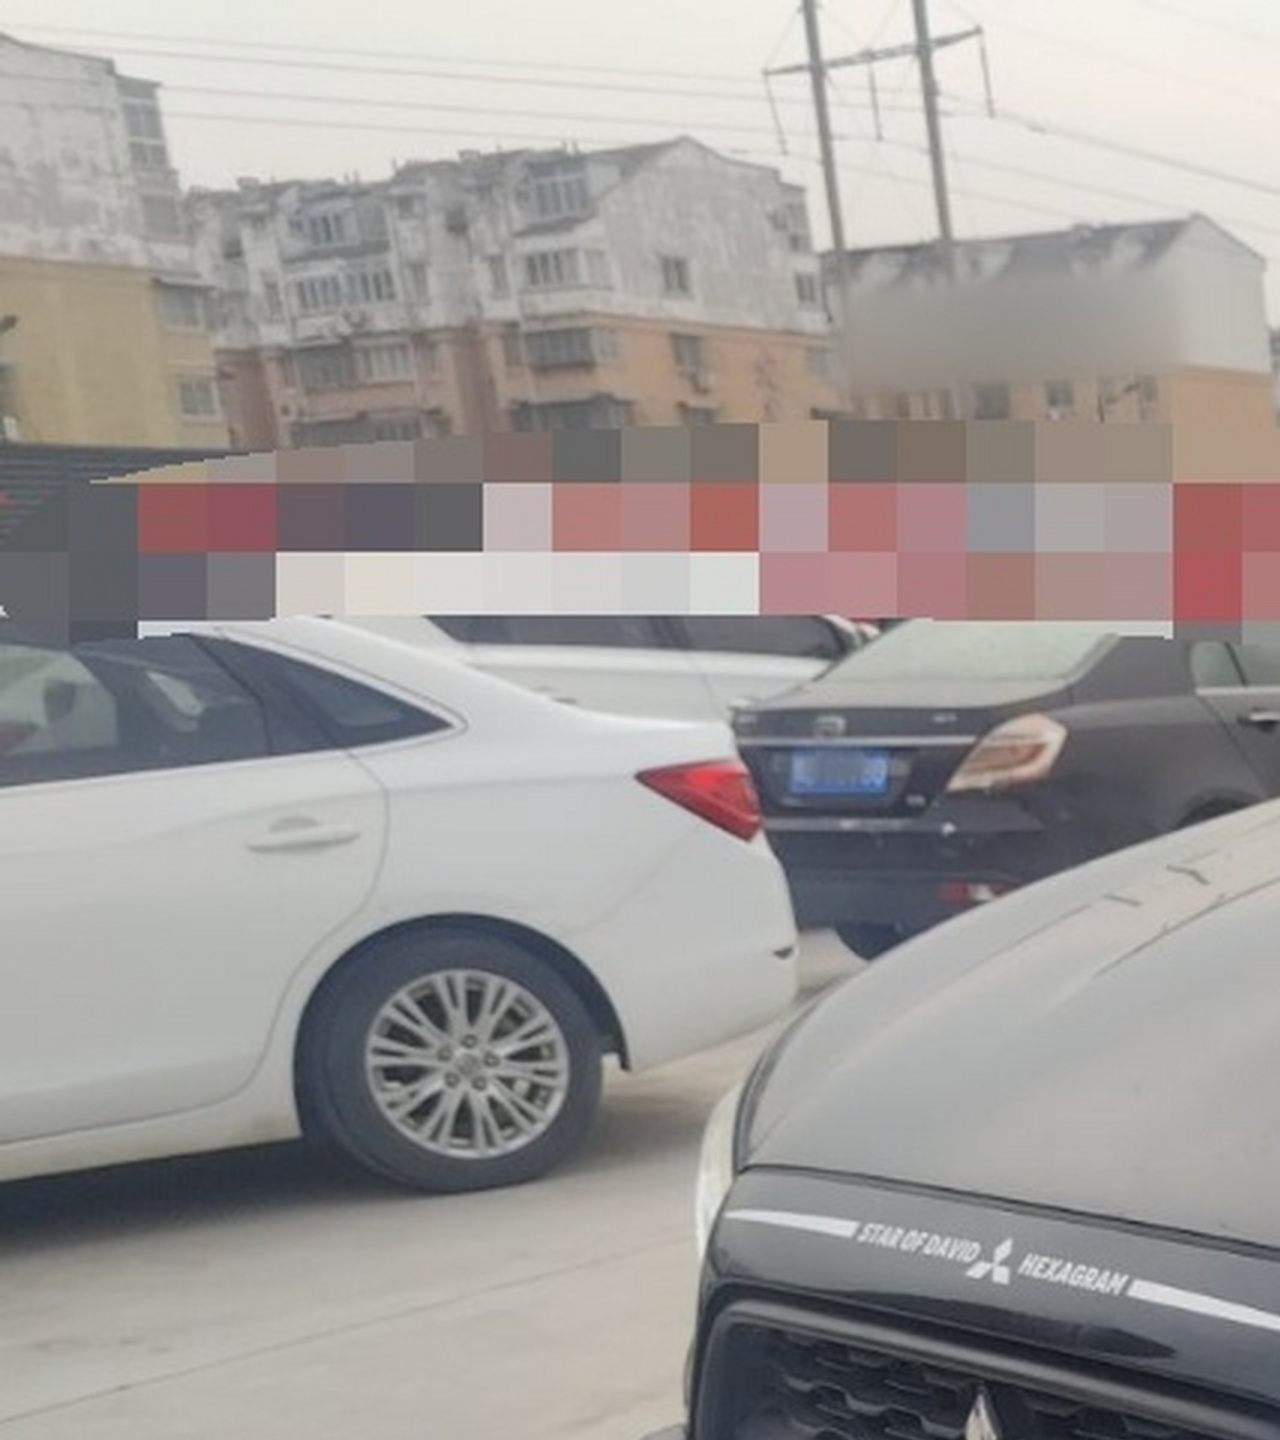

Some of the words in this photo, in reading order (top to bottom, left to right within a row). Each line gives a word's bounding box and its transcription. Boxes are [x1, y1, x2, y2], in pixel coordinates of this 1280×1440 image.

[857, 1223, 903, 1249] STAR
[900, 1229, 928, 1252] OF
[923, 1233, 982, 1263] DAVID
[1018, 1253, 1129, 1296] HEXAGRAM
